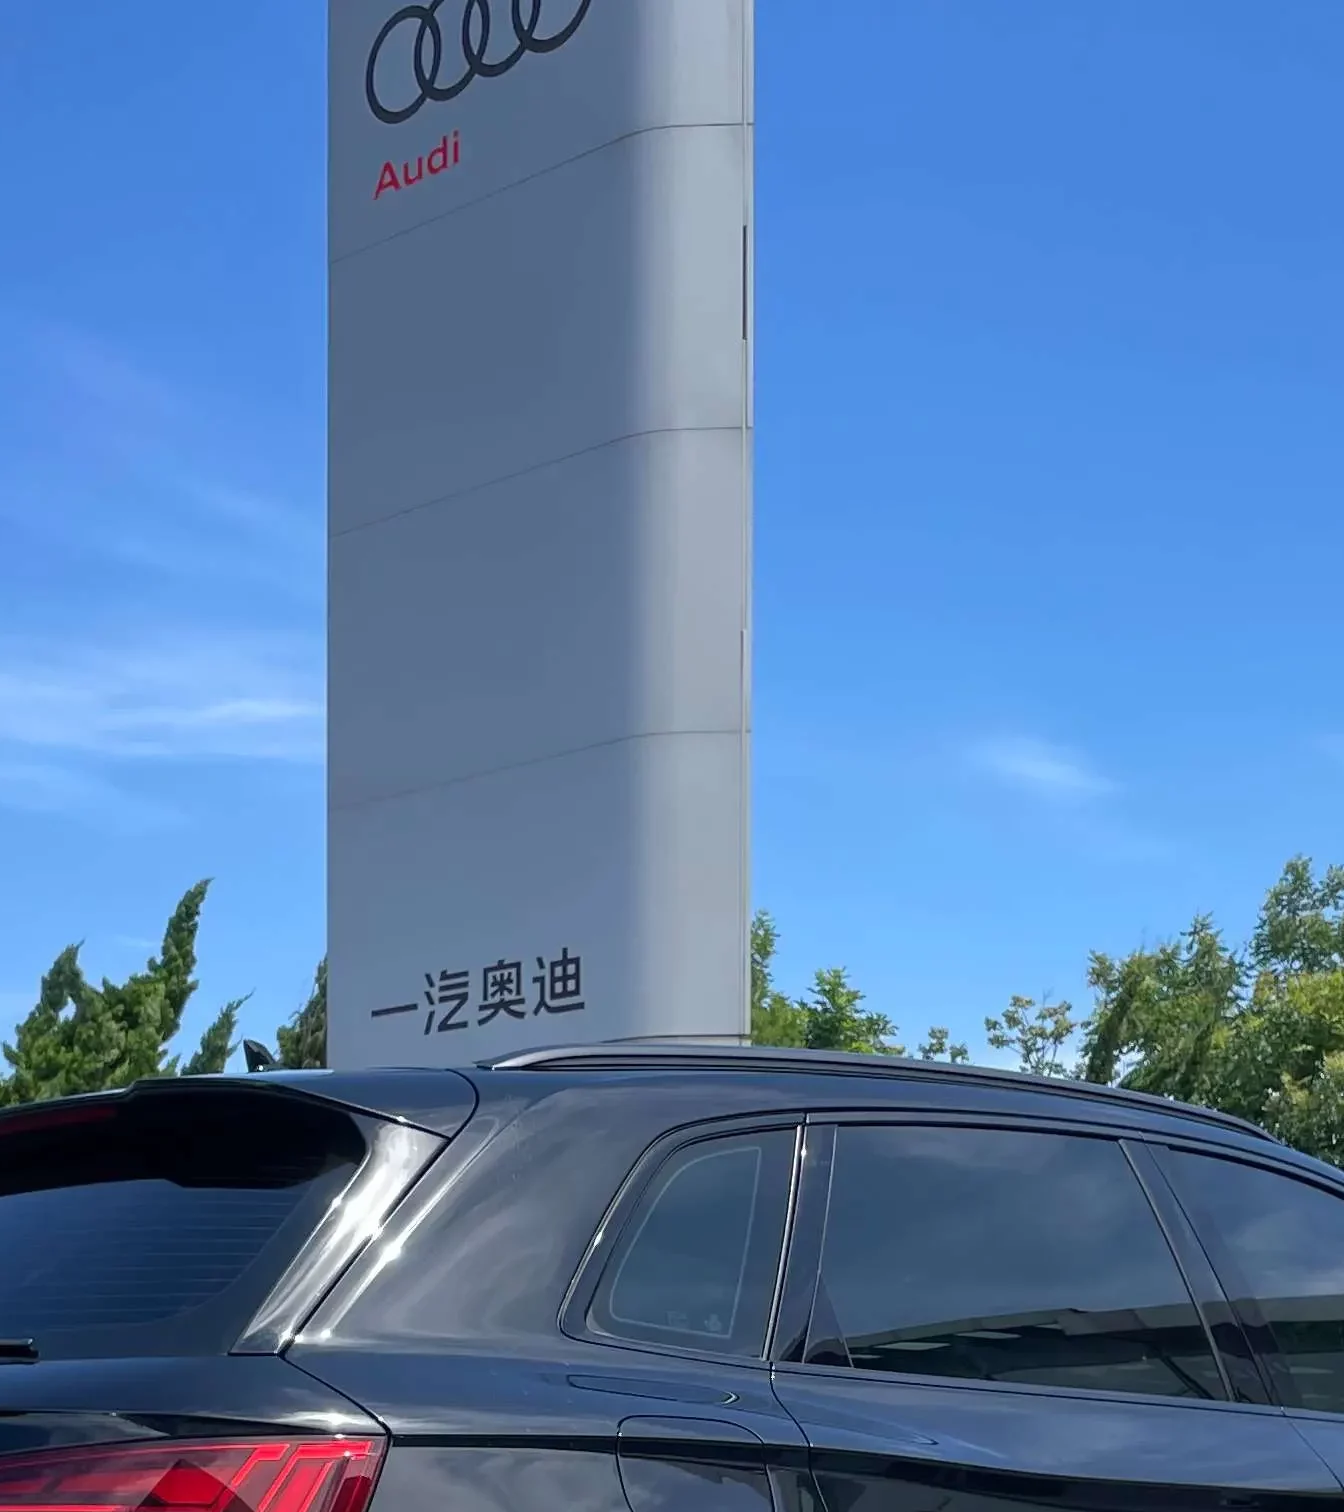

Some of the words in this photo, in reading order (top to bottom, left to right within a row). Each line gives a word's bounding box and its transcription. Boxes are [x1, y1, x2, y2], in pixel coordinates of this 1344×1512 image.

[373, 130, 460, 200] Audi
[371, 947, 585, 1035] 一汽奥迪
